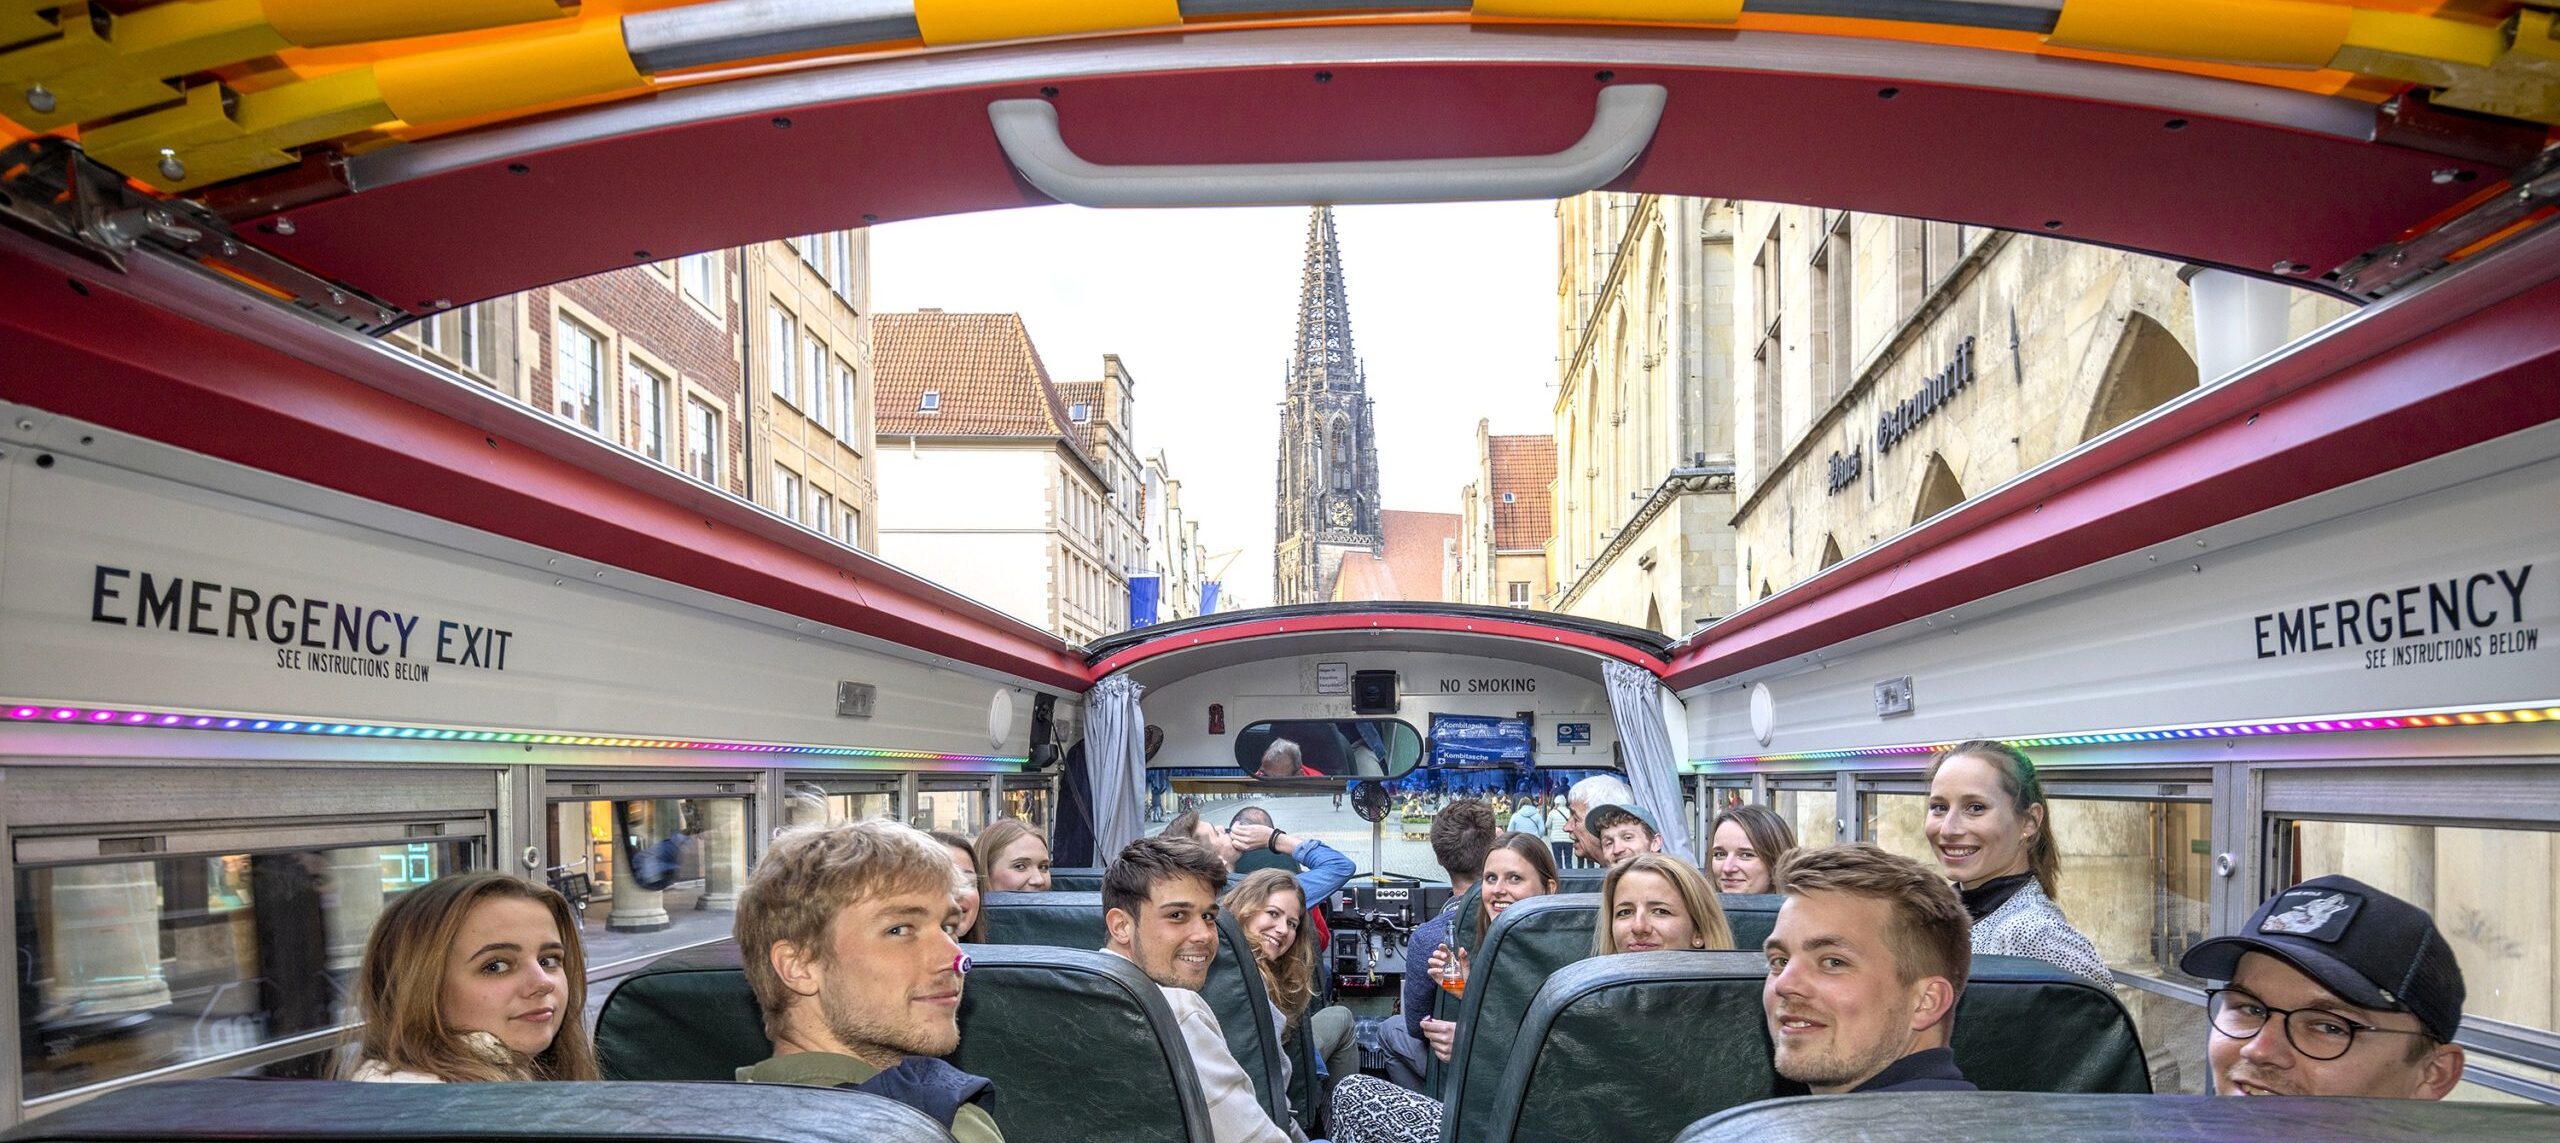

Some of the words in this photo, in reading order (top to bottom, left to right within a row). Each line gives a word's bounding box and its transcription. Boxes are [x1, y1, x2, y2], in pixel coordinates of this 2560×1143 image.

[1876, 335, 1976, 455] Ostendorff
[92, 565, 419, 658] EMERGENCY
[436, 620, 513, 671] EXIT
[2254, 564, 2533, 660] EMERGENCY
[277, 648, 301, 670] SEE
[307, 653, 390, 679] INSTRUCTIONS
[395, 664, 430, 683] BELOW
[2365, 650, 2387, 670] SEE
[2392, 636, 2482, 667] INSTRUCTIONS
[2489, 628, 2538, 656] BELOW
[1440, 679, 1460, 692] NO
[1468, 679, 1536, 692] SMOKING
[1443, 721, 1488, 730] Kombitasche
[1443, 752, 1489, 761] Kombitasche
